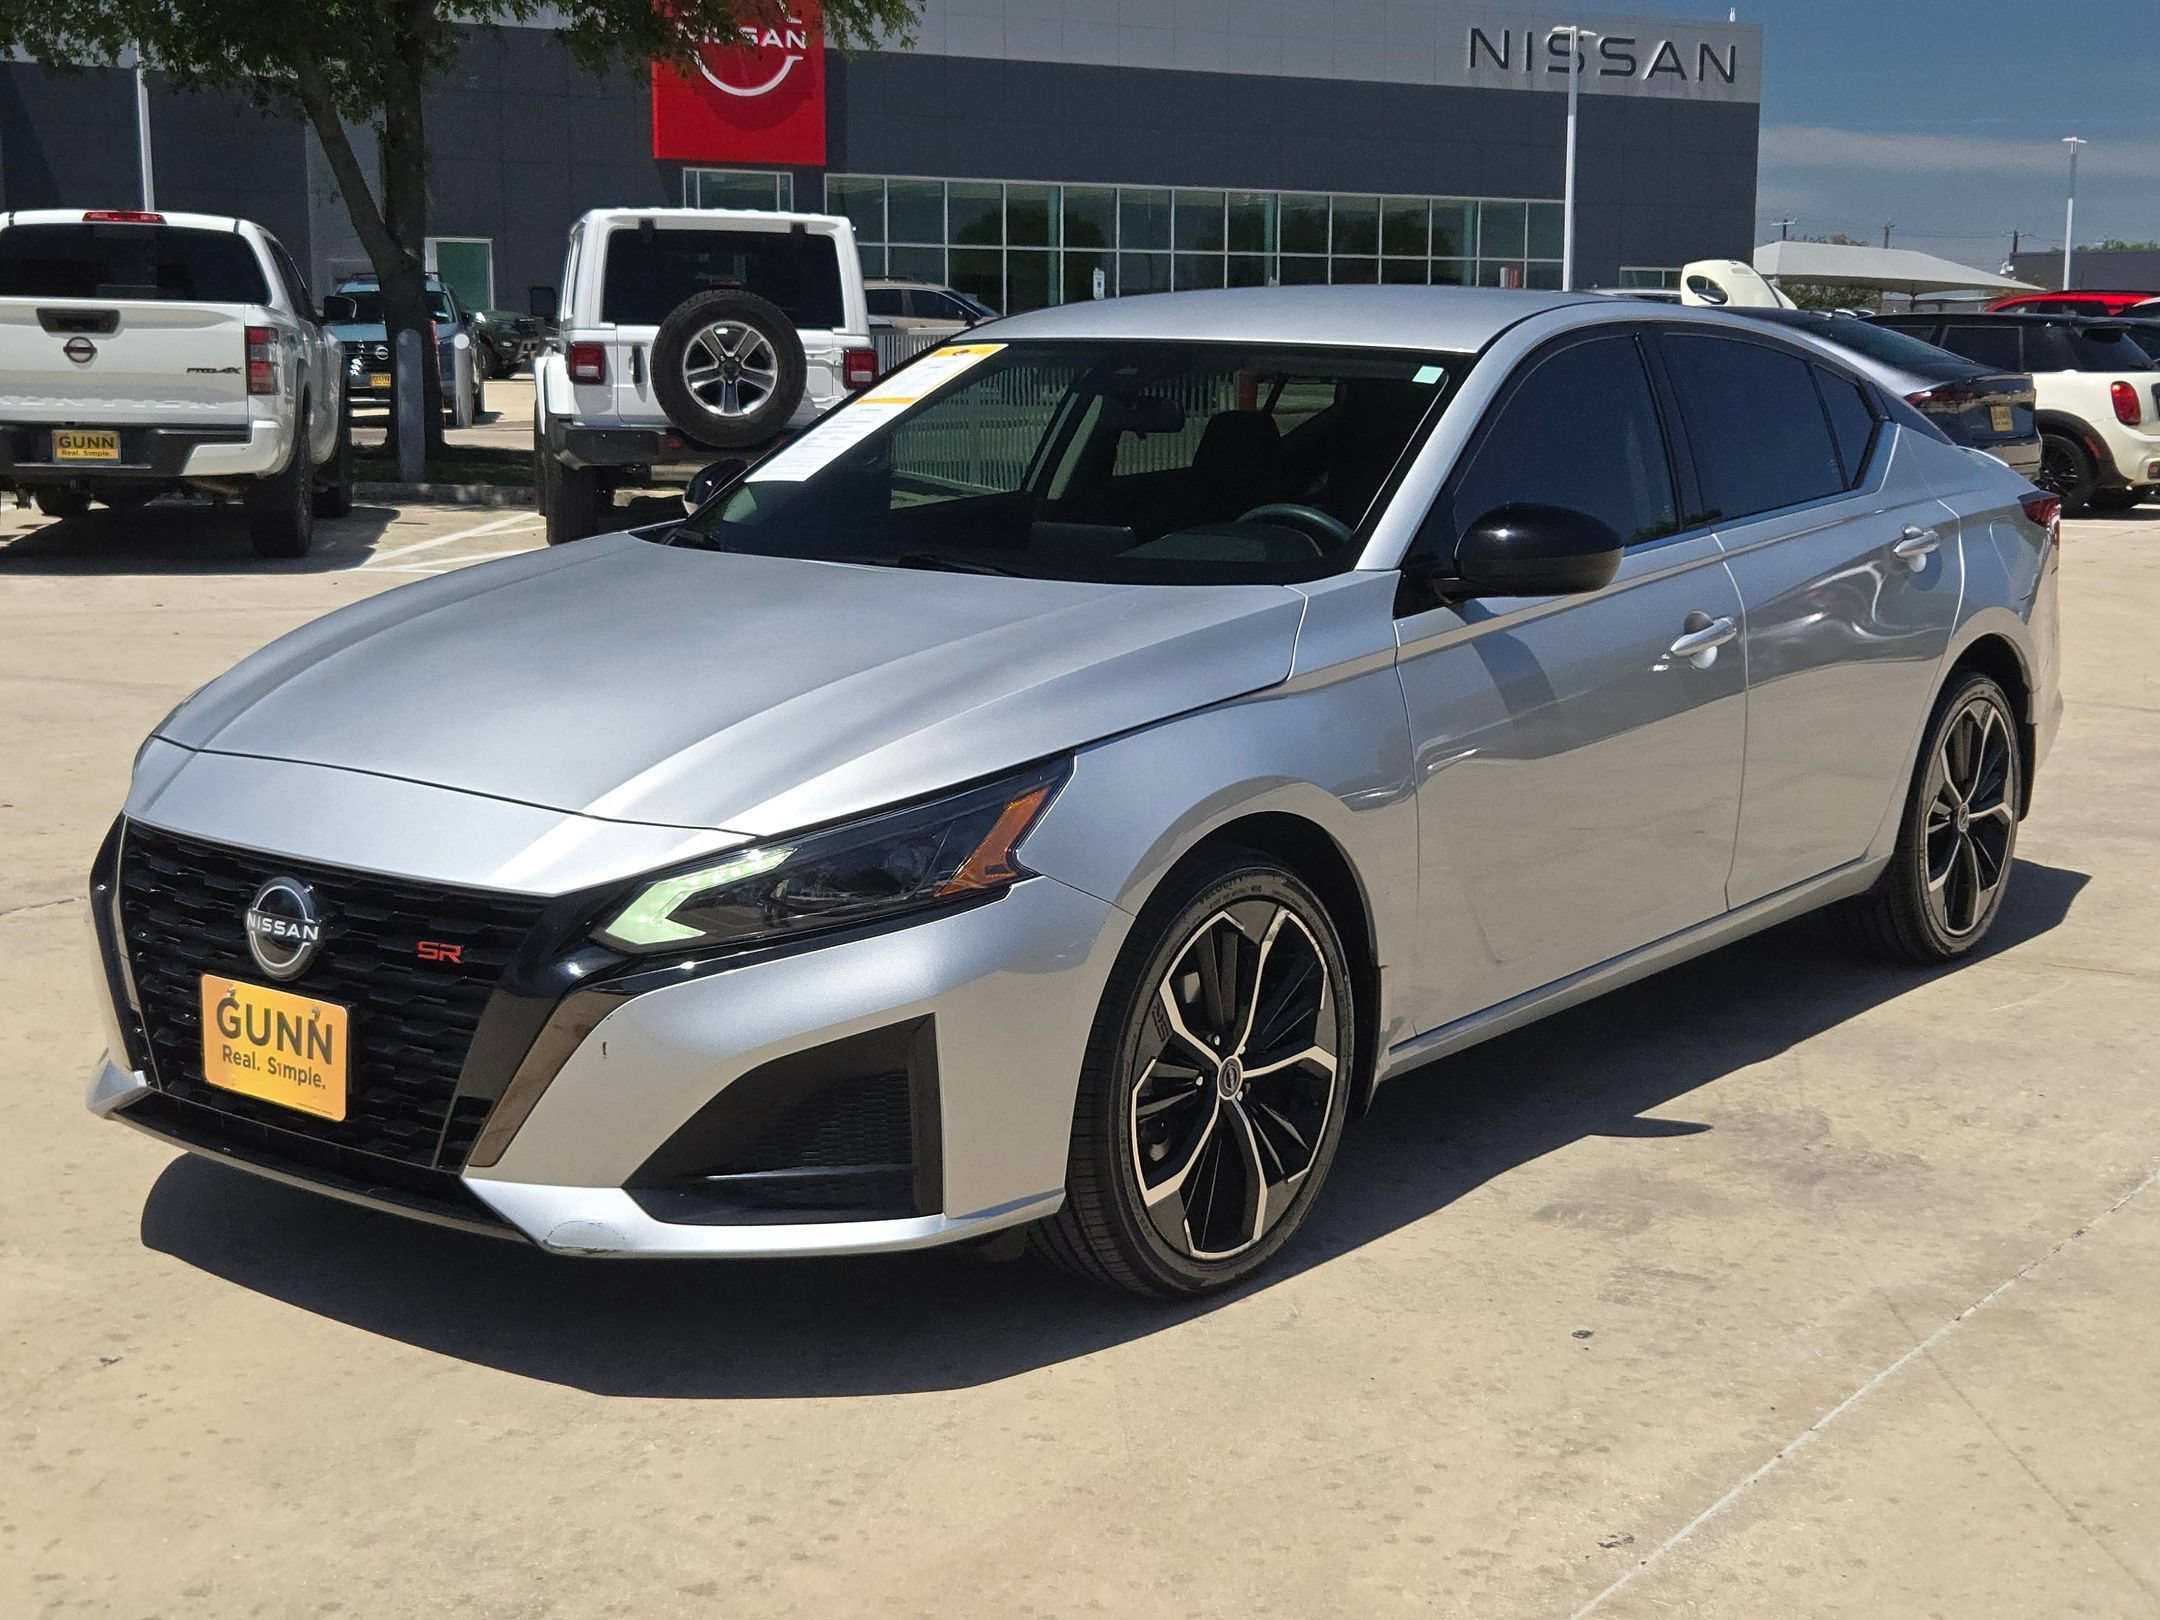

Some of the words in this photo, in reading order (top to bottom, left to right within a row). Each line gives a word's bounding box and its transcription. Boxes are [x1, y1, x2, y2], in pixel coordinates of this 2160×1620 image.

[1468, 27, 1736, 84] NISSAN
[59, 436, 115, 449] GUNN
[246, 911, 319, 940] NISSAN
[416, 940, 464, 964] SR
[216, 996, 333, 1066] GUNN
[222, 1044, 261, 1071] Real.
